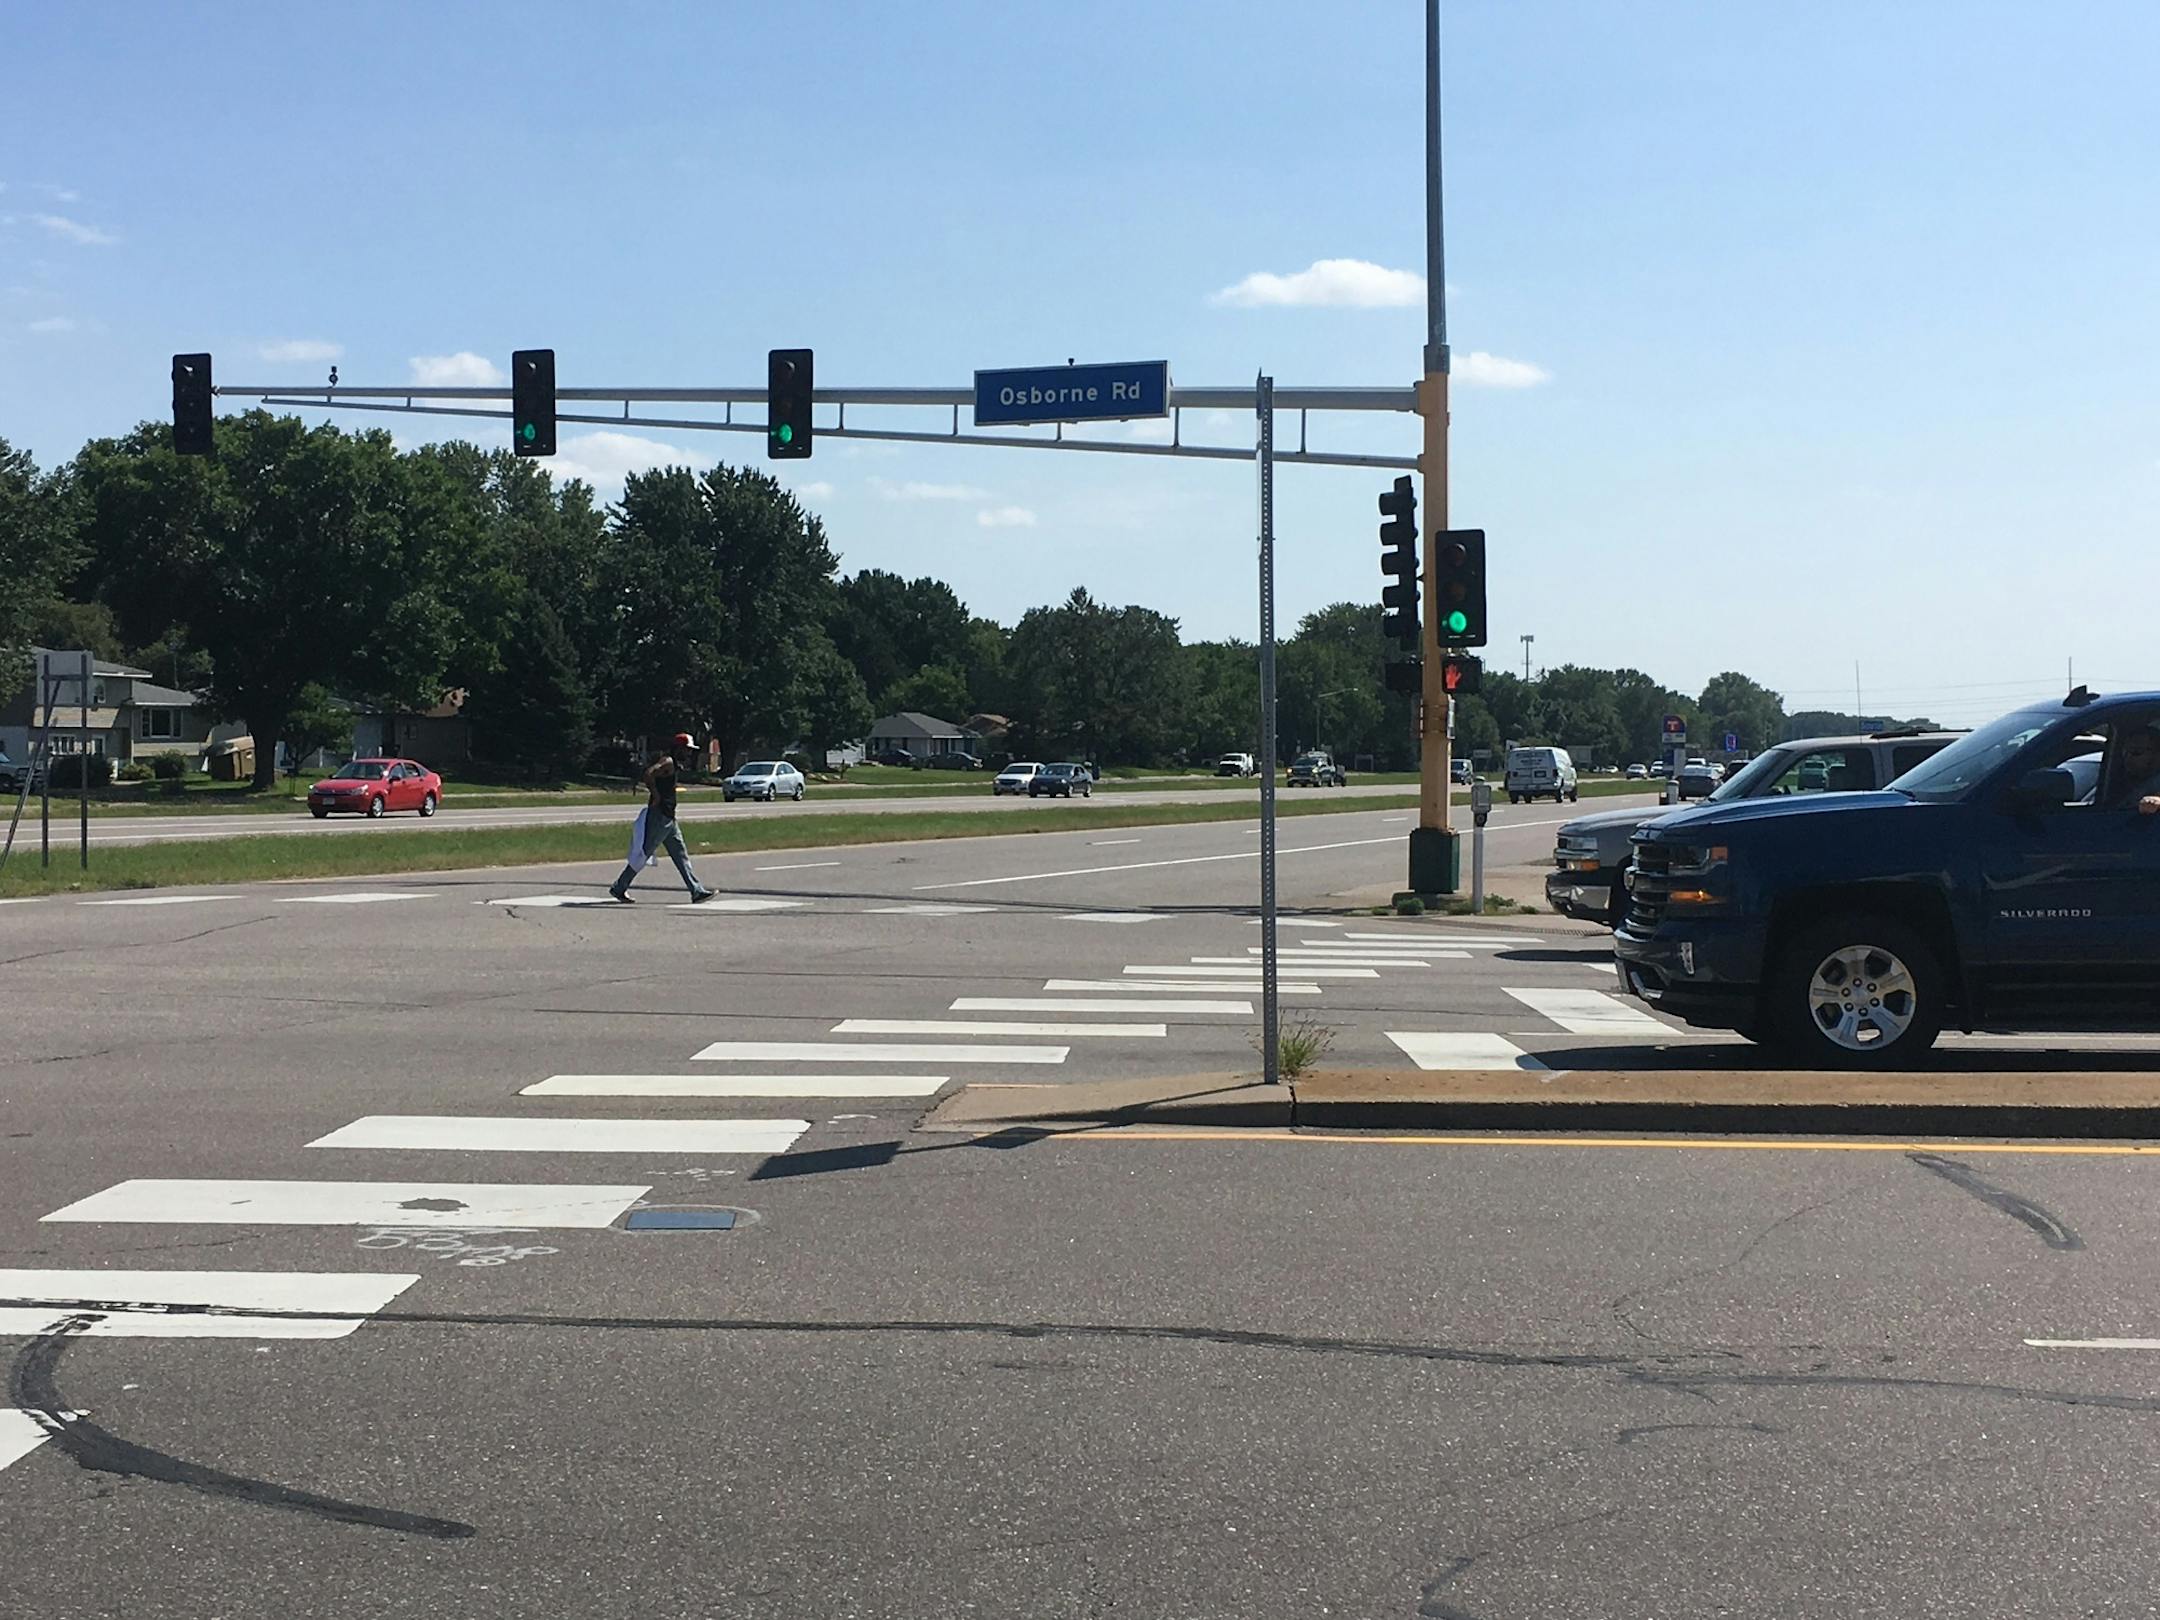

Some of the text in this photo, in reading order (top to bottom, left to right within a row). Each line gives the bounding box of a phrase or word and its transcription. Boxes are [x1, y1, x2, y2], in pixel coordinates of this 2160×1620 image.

[1000, 381, 1141, 406] Osborne Rd
[2000, 908, 2093, 918] SILVERADO
